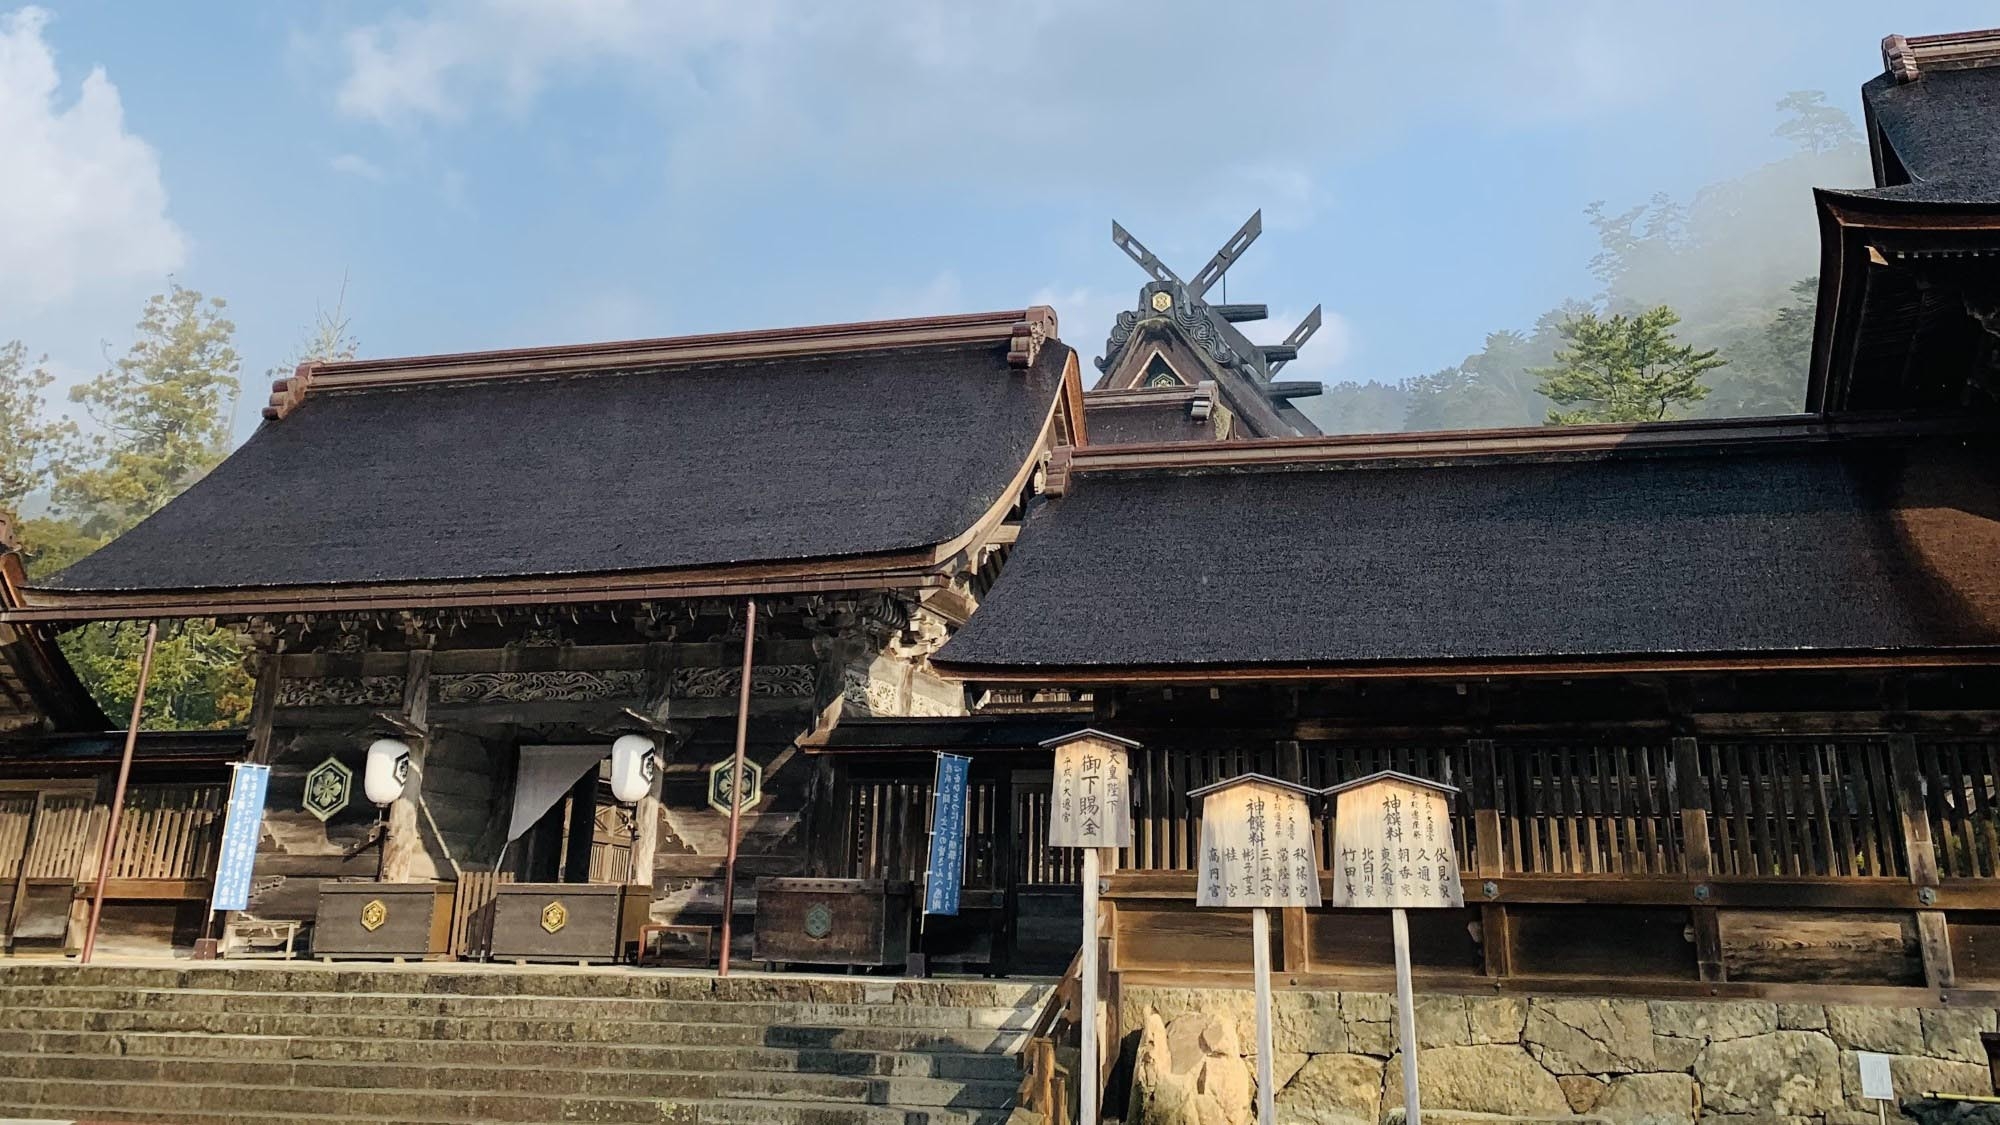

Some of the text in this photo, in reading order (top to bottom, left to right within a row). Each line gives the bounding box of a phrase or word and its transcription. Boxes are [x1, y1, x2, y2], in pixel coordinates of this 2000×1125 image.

[1079, 754, 1102, 836] 御下賜金
[1106, 749, 1121, 814] 天皇陛下
[1207, 847, 1221, 898] 高円宮
[1259, 848, 1273, 898] 三笠宮
[1276, 847, 1290, 898] 常陸宮
[1292, 847, 1309, 898] 秋篠宮
[1341, 847, 1358, 898] 竹田家
[1361, 847, 1376, 898] 北白川家
[1398, 847, 1413, 897] 朝香家
[1434, 847, 1451, 899] 伏見家
